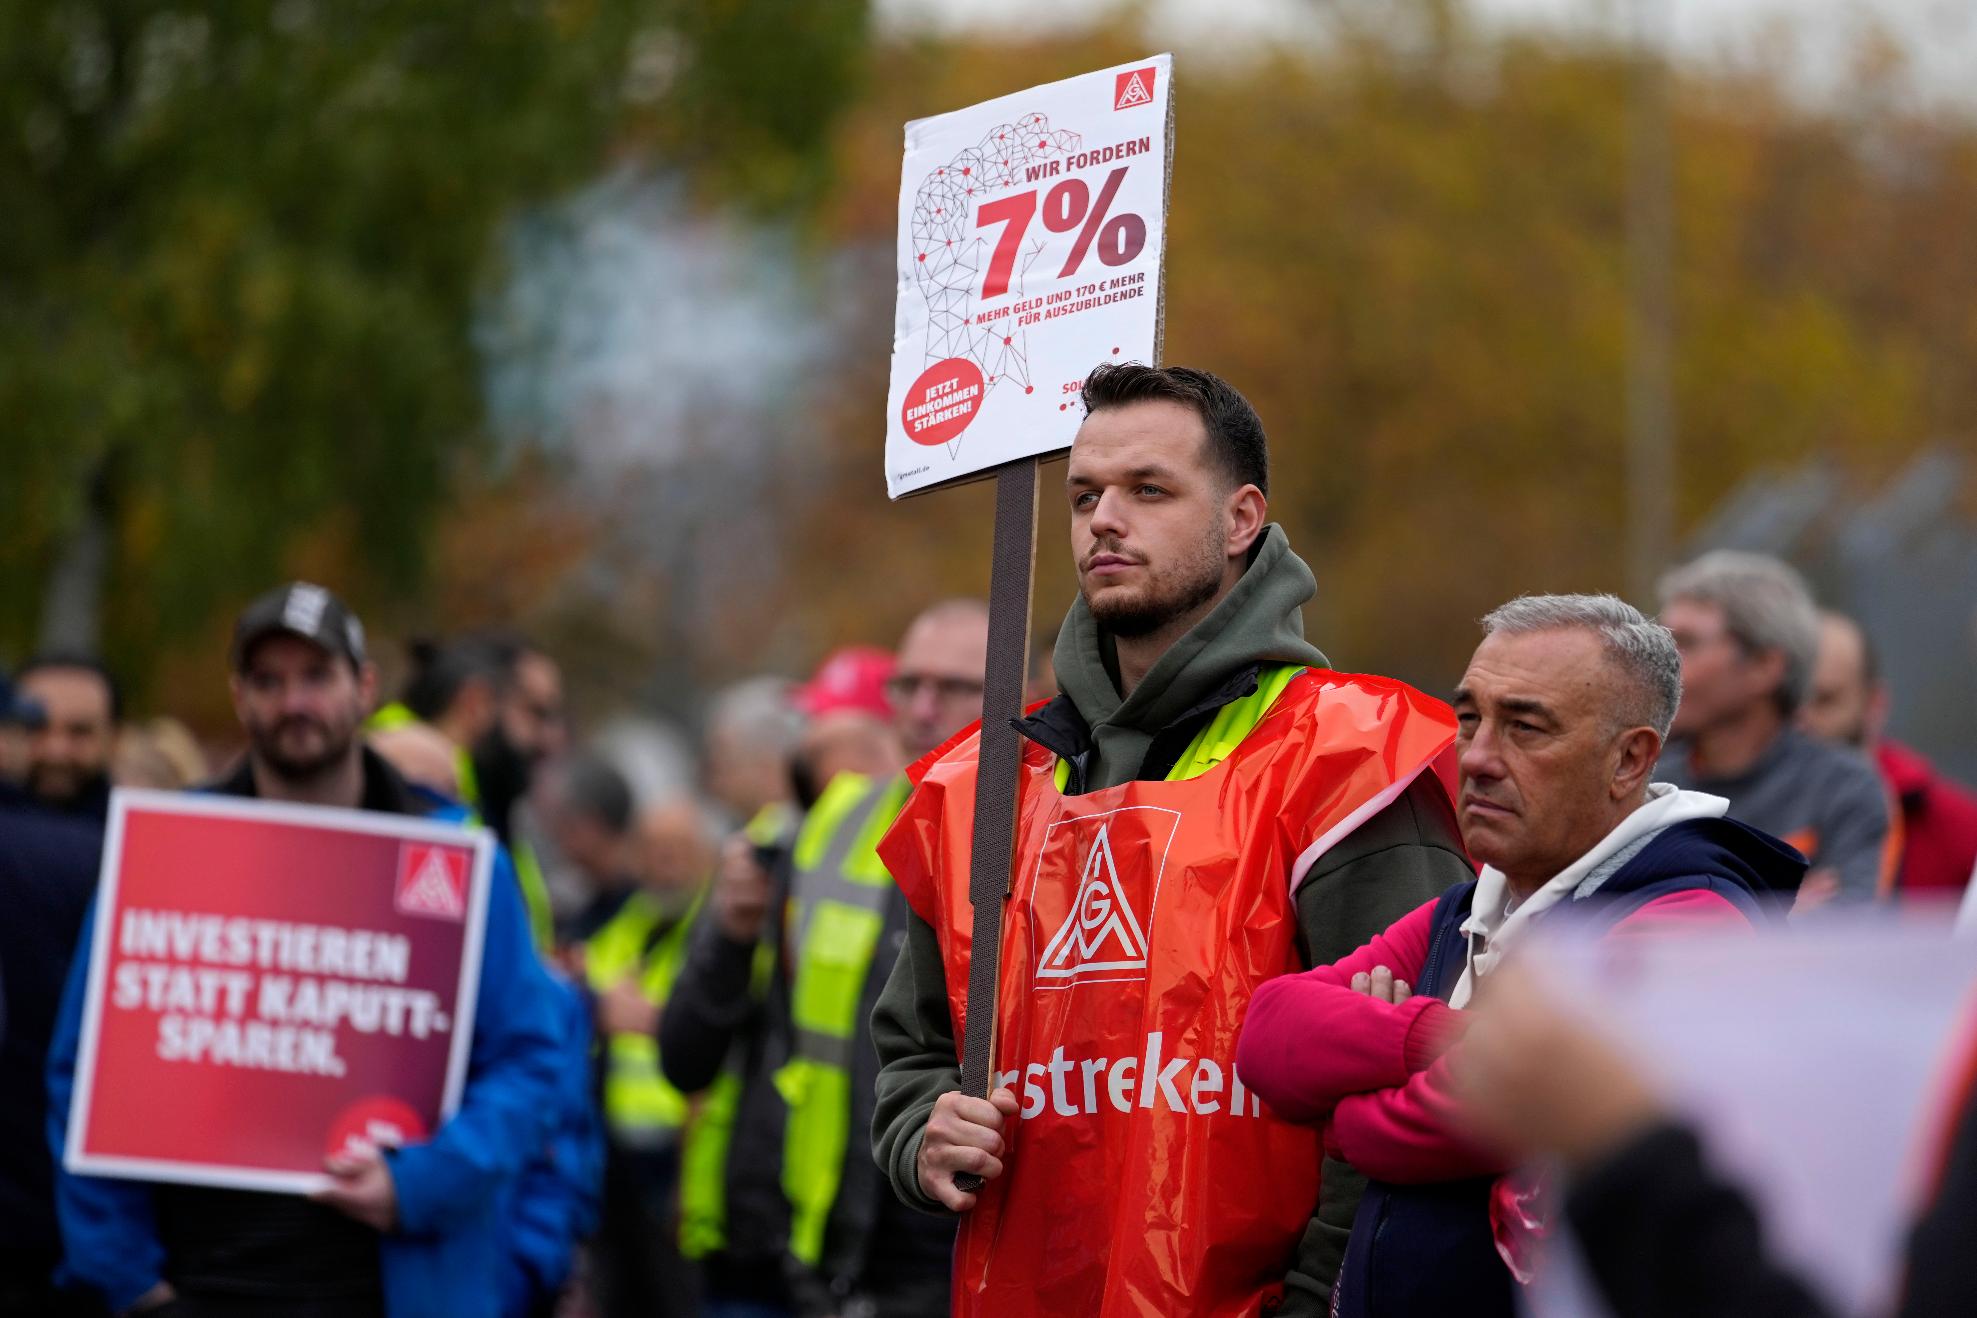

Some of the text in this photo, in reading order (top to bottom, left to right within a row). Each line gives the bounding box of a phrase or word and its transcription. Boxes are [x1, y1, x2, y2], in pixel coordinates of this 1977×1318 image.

[1025, 136, 1151, 183] WIR FORDERN
[976, 166, 1147, 300] 7%
[976, 272, 1145, 325] MEHR GELD UND 170 € MEHR
[1017, 286, 1144, 327] FÜR AUSZUBILDENDE
[906, 383, 979, 422] EINKOMMEN
[925, 377, 959, 403] JETZT
[914, 400, 972, 433] STÄRKEN!
[120, 908, 411, 983] INVESTIEREN
[113, 962, 451, 1039] STATT KAPUTT-
[157, 1014, 347, 1078] SPAREN.
